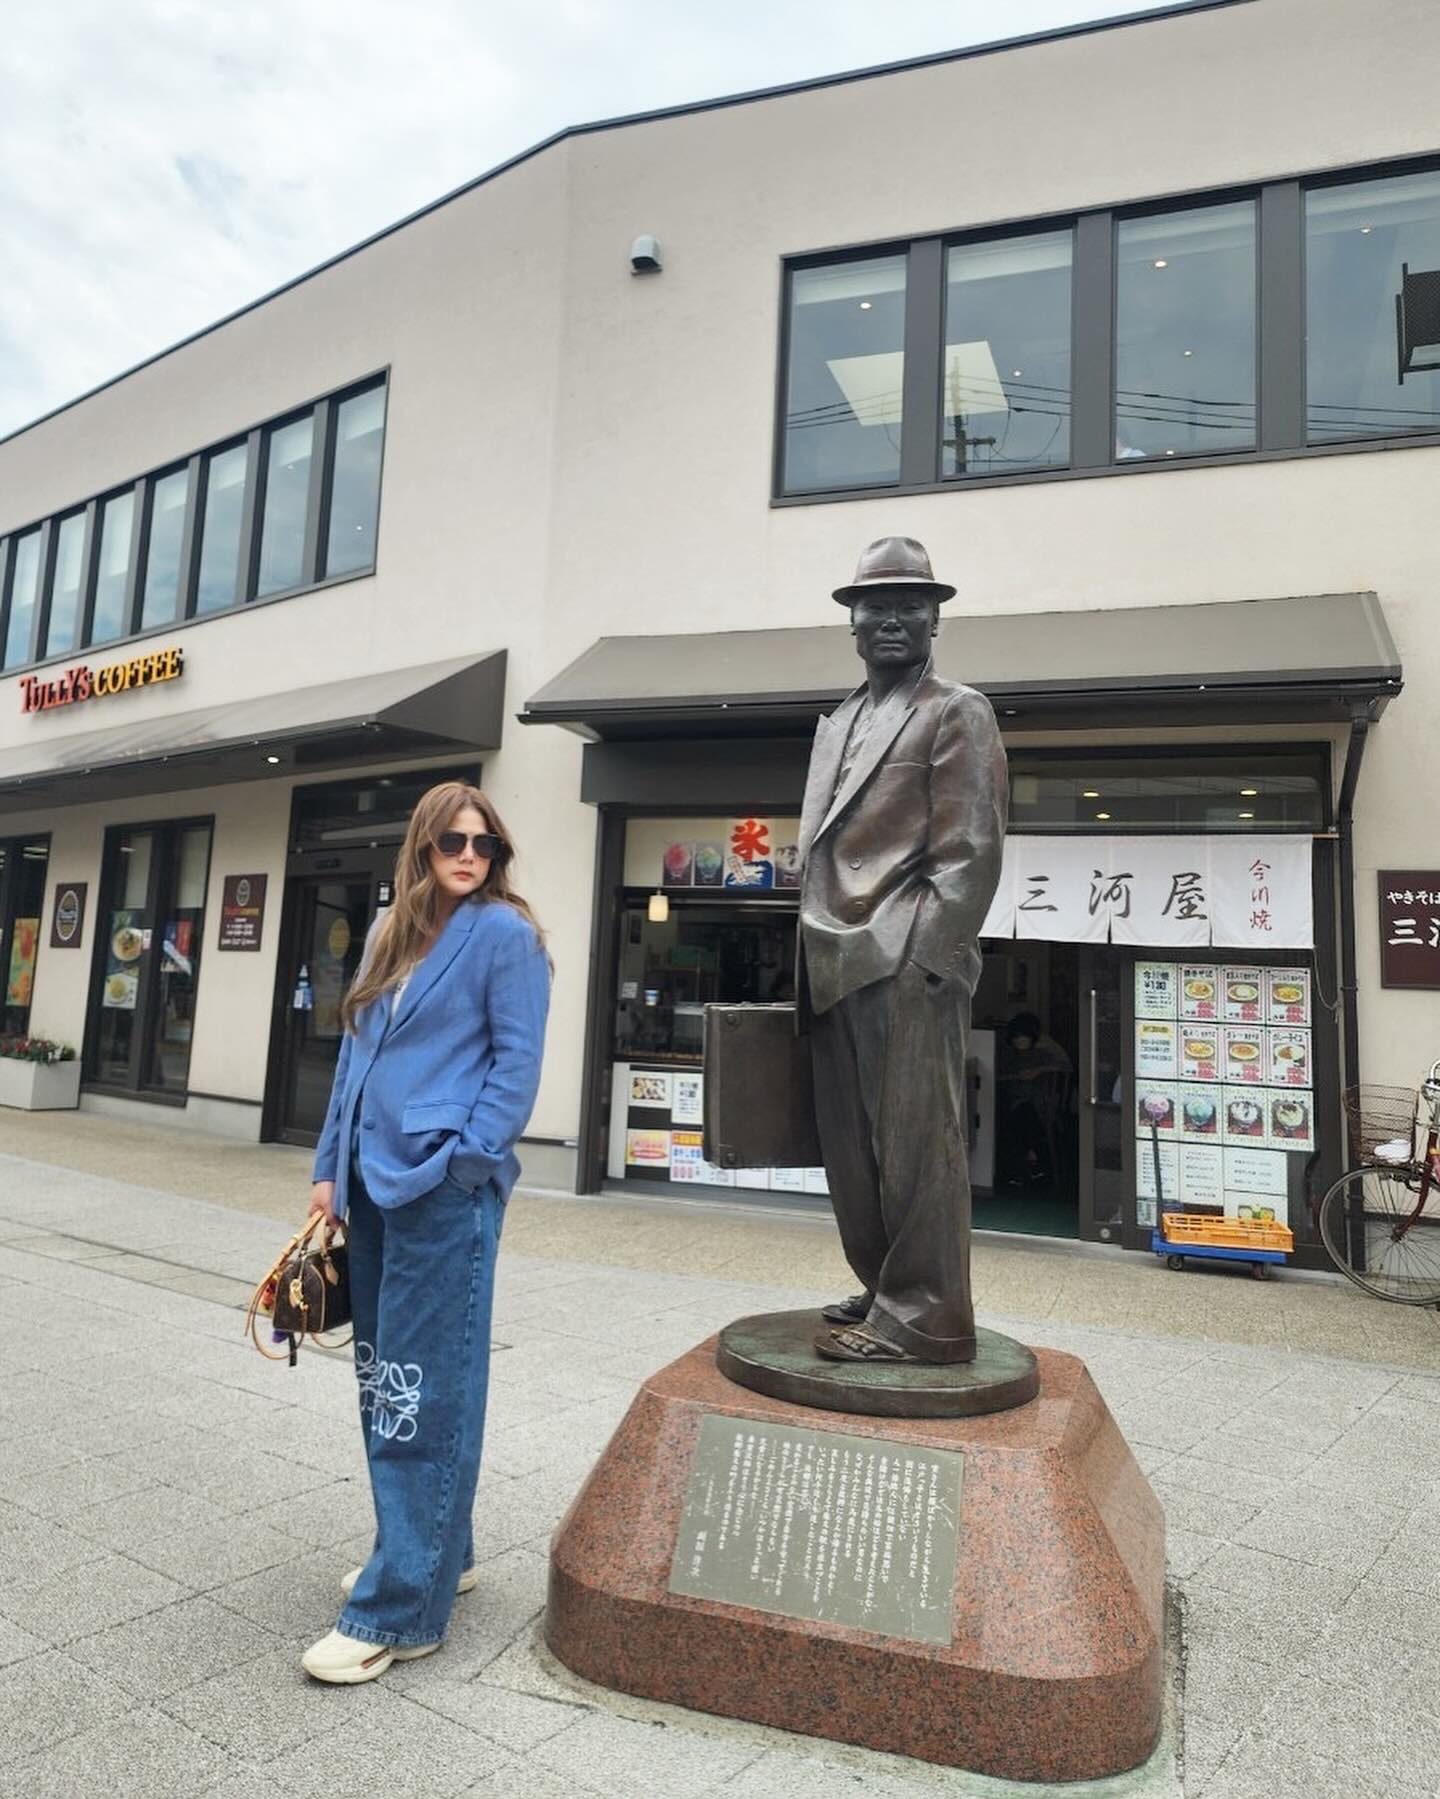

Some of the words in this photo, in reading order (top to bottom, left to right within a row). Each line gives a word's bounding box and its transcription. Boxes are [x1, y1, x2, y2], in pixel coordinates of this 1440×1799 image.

[93, 646, 184, 698] COFFEE
[731, 818, 770, 862] 氷
[1018, 869, 1208, 921] 三河屋
[1249, 858, 1273, 932] 今川焼
